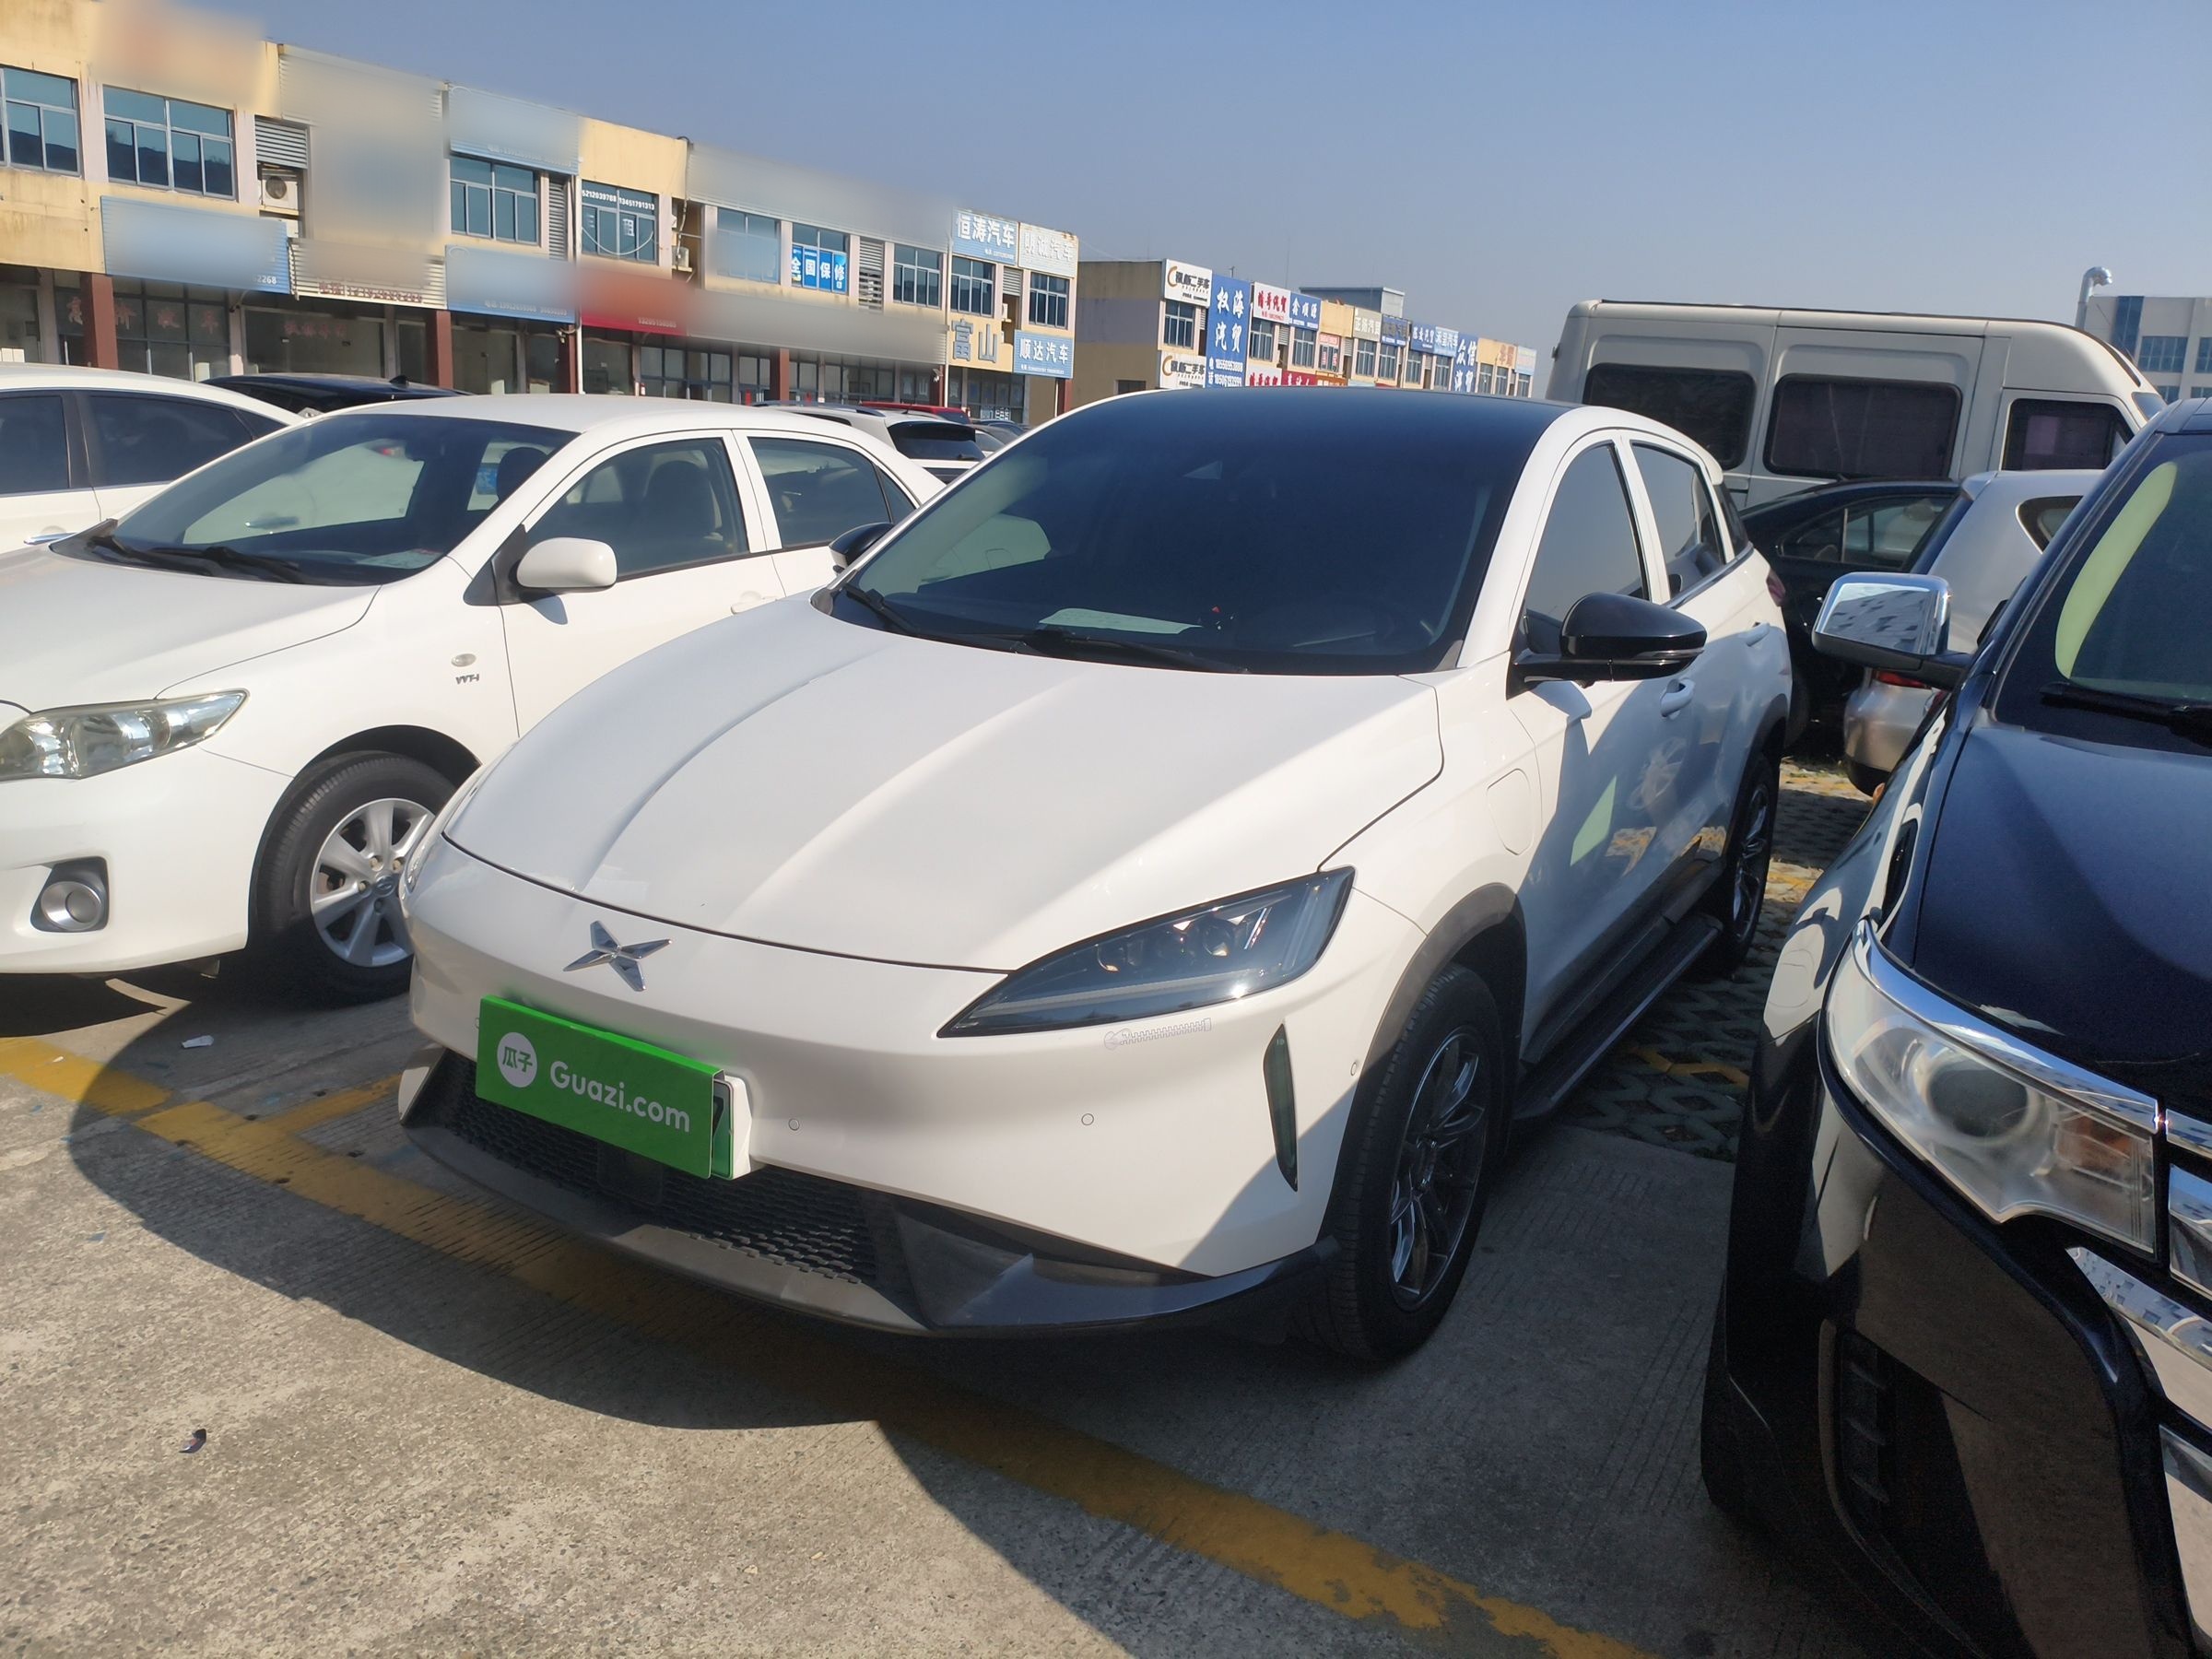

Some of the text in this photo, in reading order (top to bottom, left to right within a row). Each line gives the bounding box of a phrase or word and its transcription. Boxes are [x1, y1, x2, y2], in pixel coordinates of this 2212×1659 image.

[956, 212, 1015, 249] 恒涛汽车
[792, 256, 845, 281] 全国保修
[951, 319, 997, 364] 富山
[1019, 337, 1069, 365] 顺达汽车
[502, 1045, 534, 1074] 瓜子
[549, 1060, 690, 1133] Guazi.com
